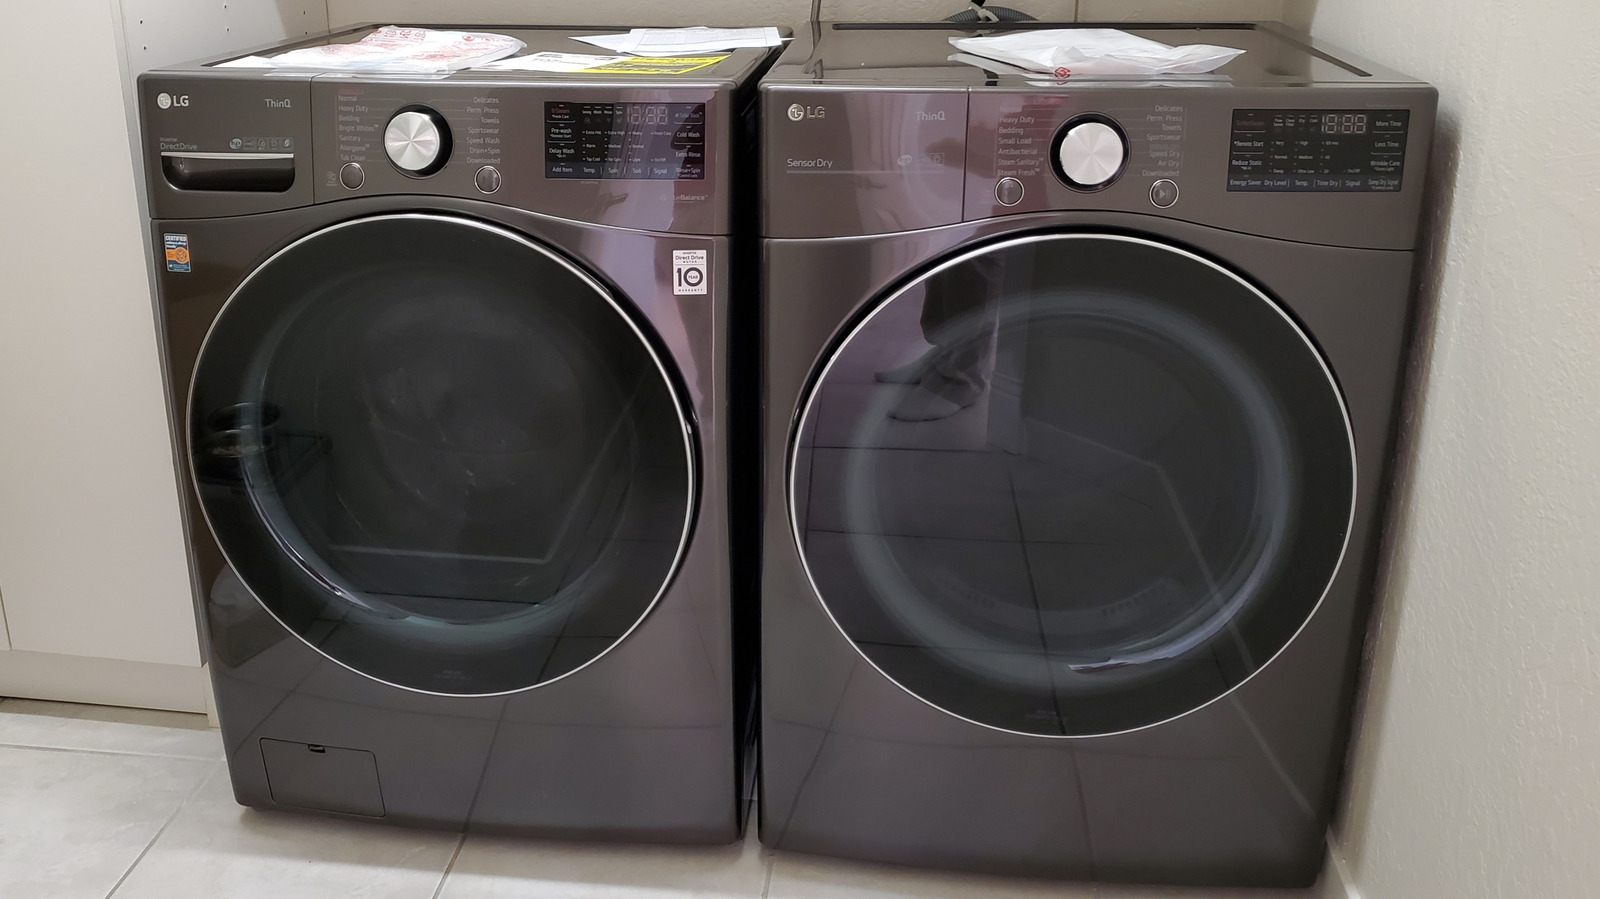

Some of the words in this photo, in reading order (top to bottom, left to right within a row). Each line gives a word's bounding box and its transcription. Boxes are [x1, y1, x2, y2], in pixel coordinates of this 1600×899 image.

[173, 95, 189, 107] LG
[265, 99, 291, 108] ThinQ
[339, 105, 354, 113] Heavy
[355, 105, 368, 113] Duty
[806, 106, 826, 119] LG
[339, 115, 359, 123] Bedding
[914, 111, 946, 121] ThinQ
[1000, 116, 1018, 124] Heavy
[1019, 116, 1034, 124] Duty
[999, 127, 1024, 135] Bedding
[1146, 133, 1181, 141] Sportswear
[677, 267, 703, 287] 10
